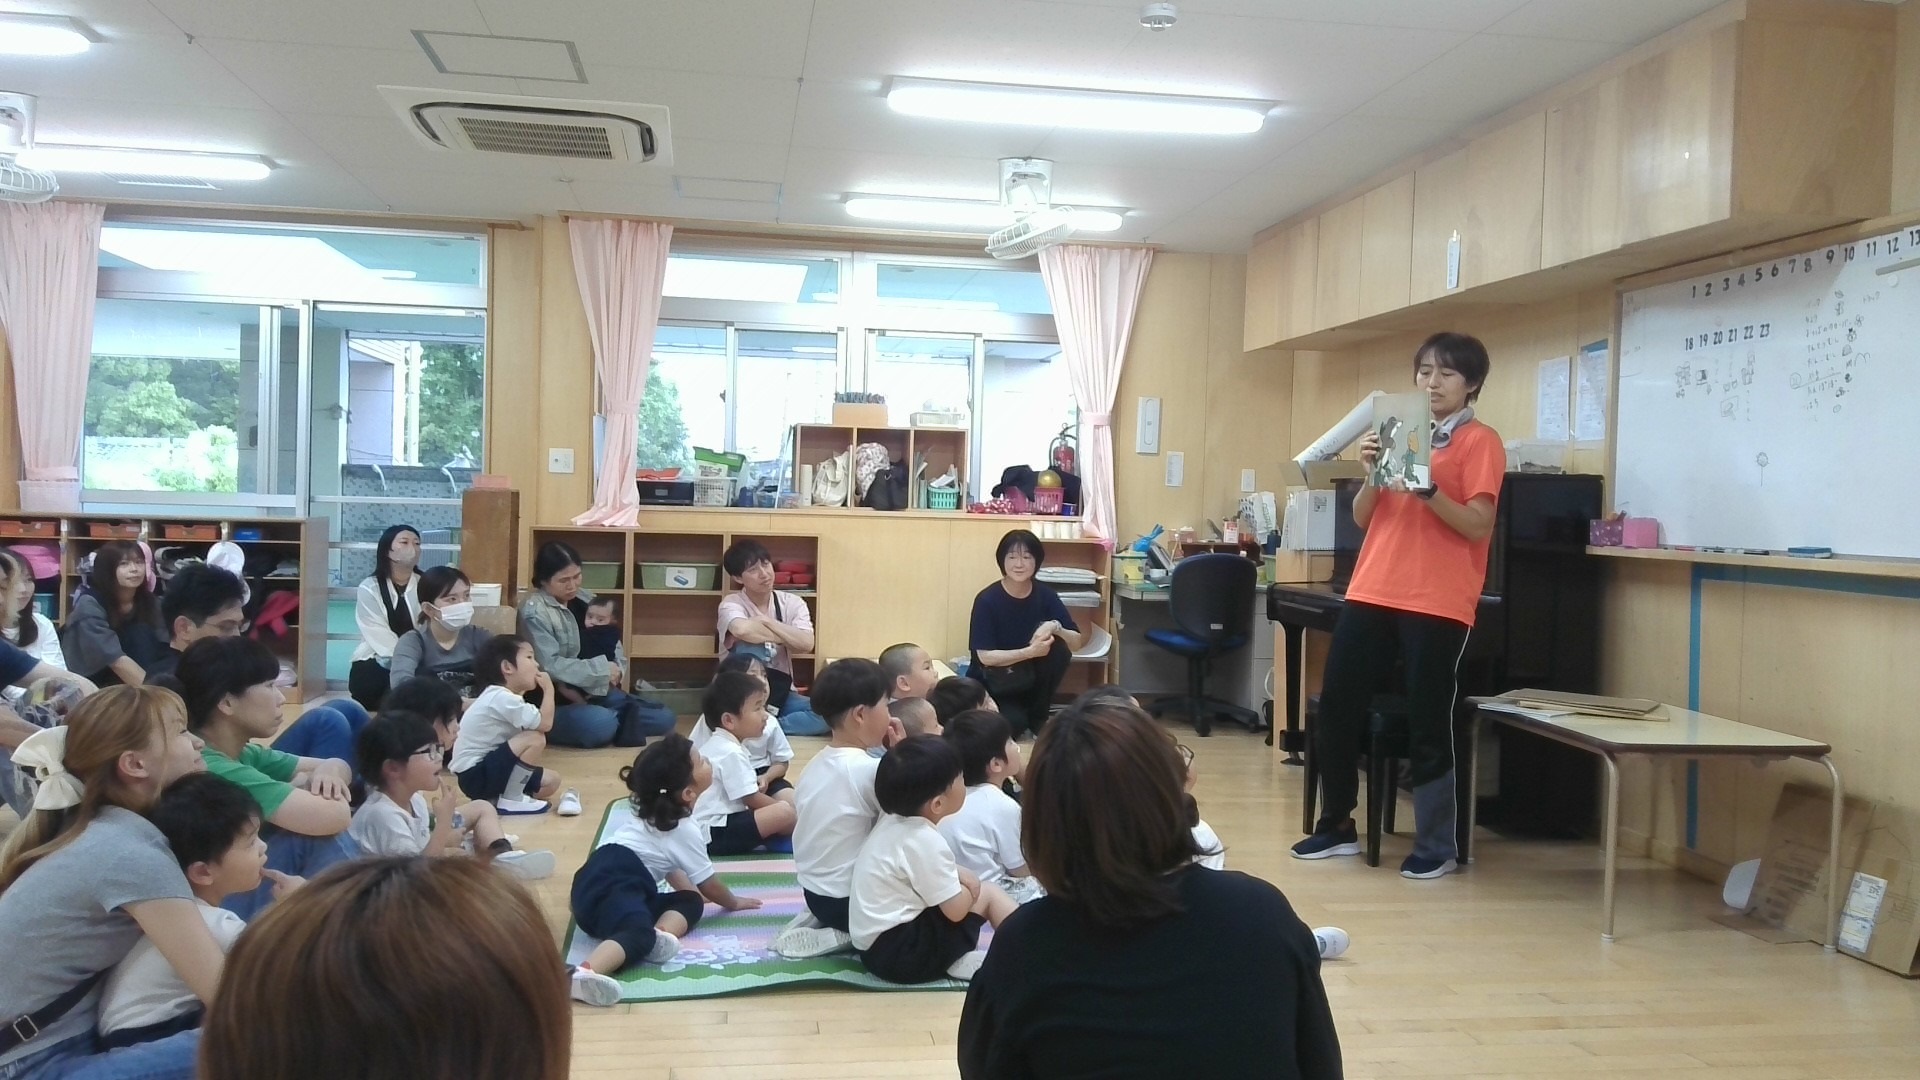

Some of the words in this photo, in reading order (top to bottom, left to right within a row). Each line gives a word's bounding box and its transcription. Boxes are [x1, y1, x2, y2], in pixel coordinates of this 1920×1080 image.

[1692, 285, 1696, 298] 1
[1705, 282, 1712, 297] 2
[1722, 277, 1730, 292] 3
[1737, 272, 1745, 287] 4
[1755, 267, 1763, 282] 5
[1771, 263, 1779, 277] 6
[1788, 258, 1796, 273] 7
[1804, 257, 1812, 273] 8
[1826, 249, 1834, 264] 9
[1844, 245, 1855, 262] 10
[1866, 240, 1877, 257] 11
[1887, 236, 1899, 255] 12
[1685, 337, 1694, 351] 18
[1699, 333, 1708, 348] 19
[1713, 330, 1723, 345] 20
[1728, 328, 1738, 343] 21
[1743, 325, 1754, 340] 22
[1760, 323, 1770, 338] 23
